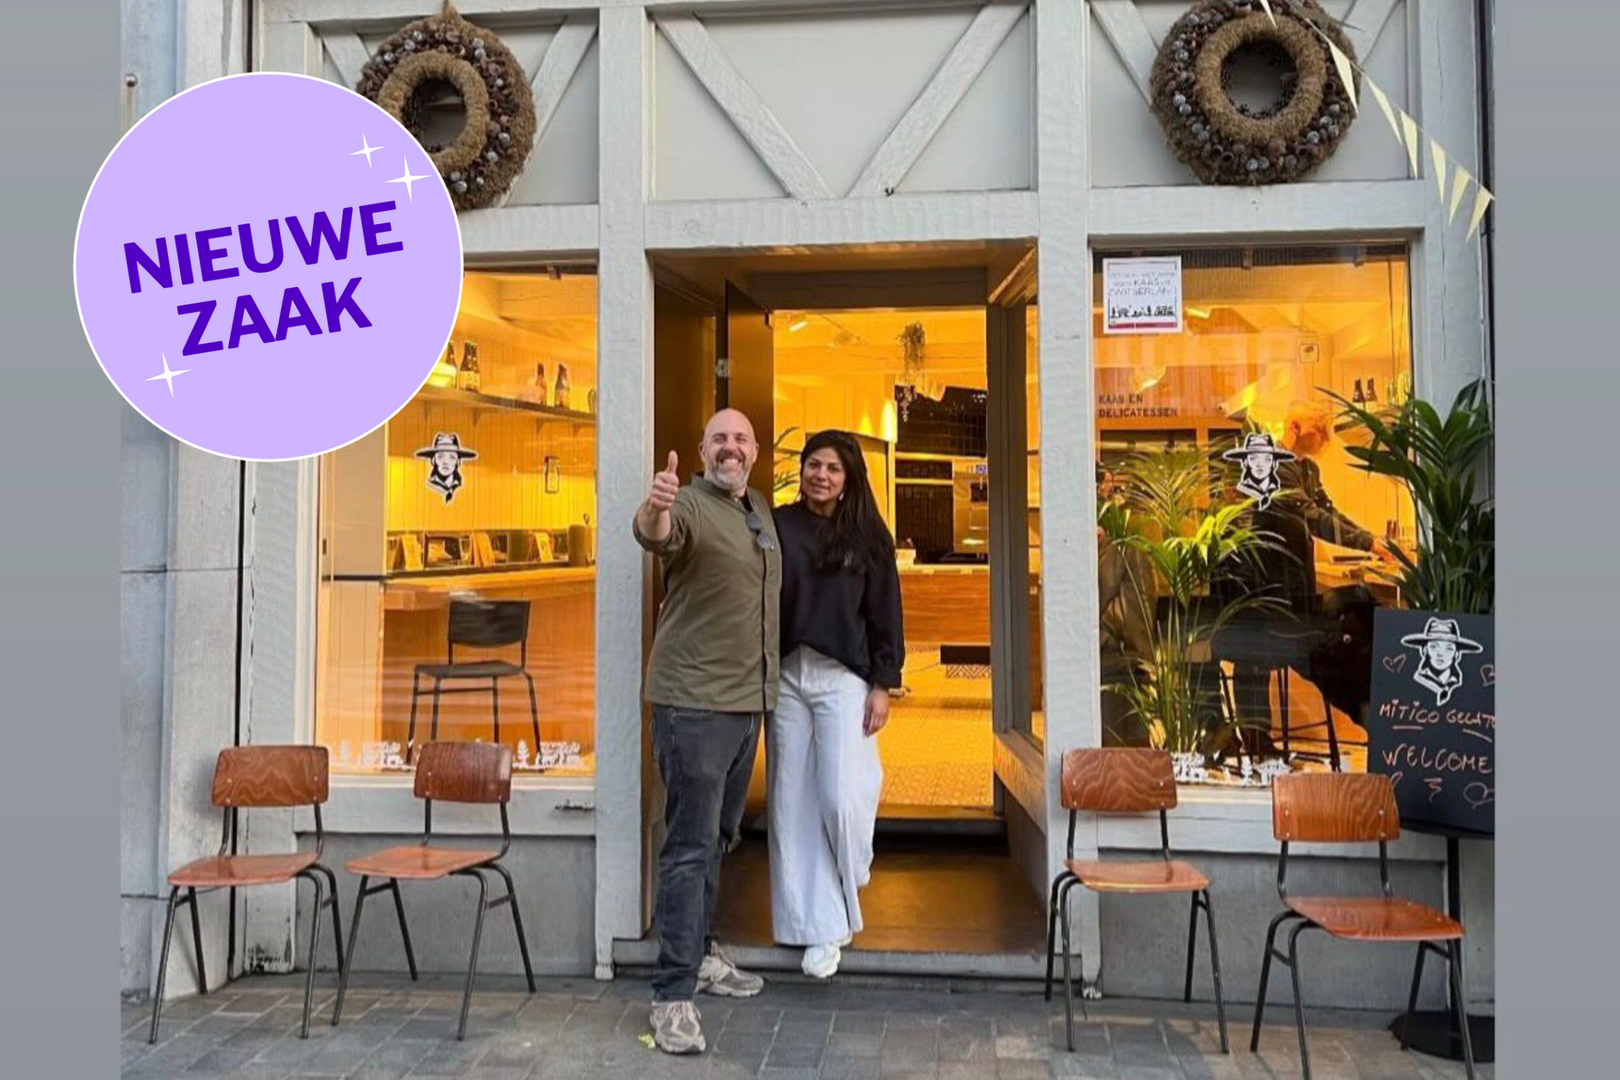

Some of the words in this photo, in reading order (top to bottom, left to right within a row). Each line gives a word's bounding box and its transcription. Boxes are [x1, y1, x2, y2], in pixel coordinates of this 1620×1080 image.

[1098, 394, 1125, 404] KAAS
[1128, 394, 1143, 404] EN
[1098, 407, 1178, 418] DELICATESSEN
[1382, 743, 1492, 774] WELCOME
